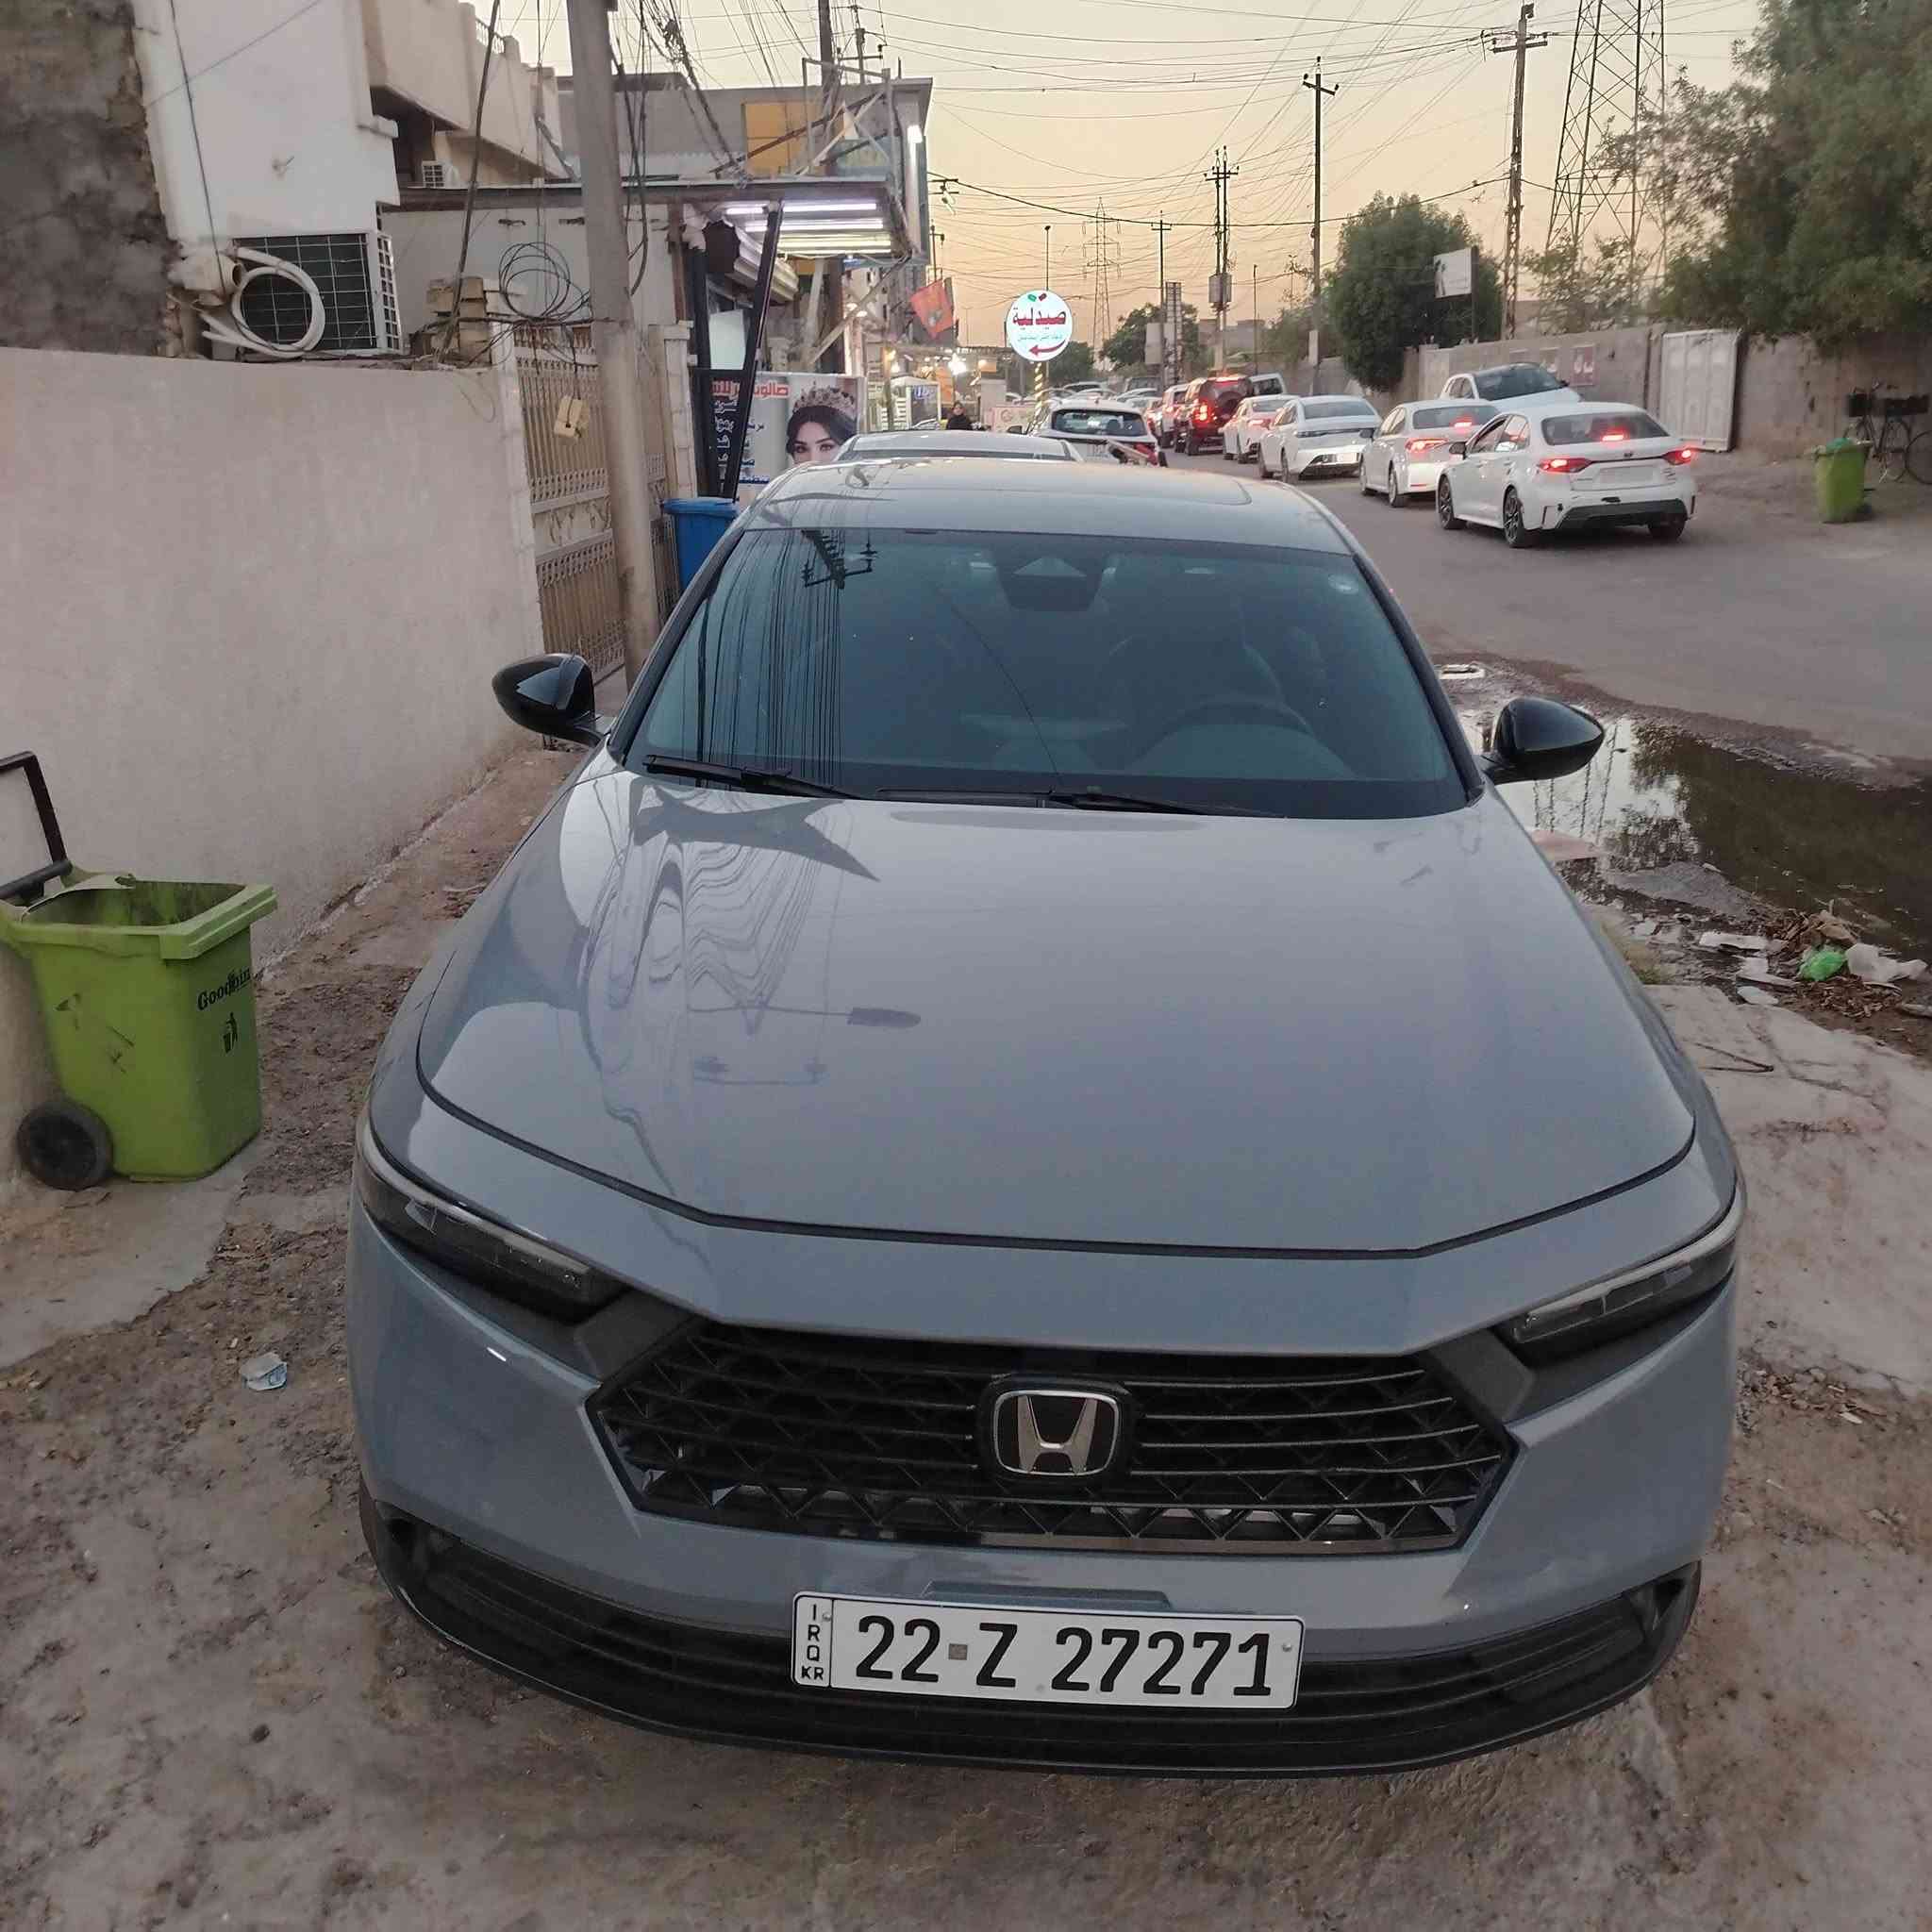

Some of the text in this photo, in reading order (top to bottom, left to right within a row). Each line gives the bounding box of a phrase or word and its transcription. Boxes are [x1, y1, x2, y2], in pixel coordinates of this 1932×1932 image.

[1012, 307, 1067, 330] صيدلية
[856, 1615, 1272, 1696] 22 Z 27271
[801, 1665, 824, 1680] KR
